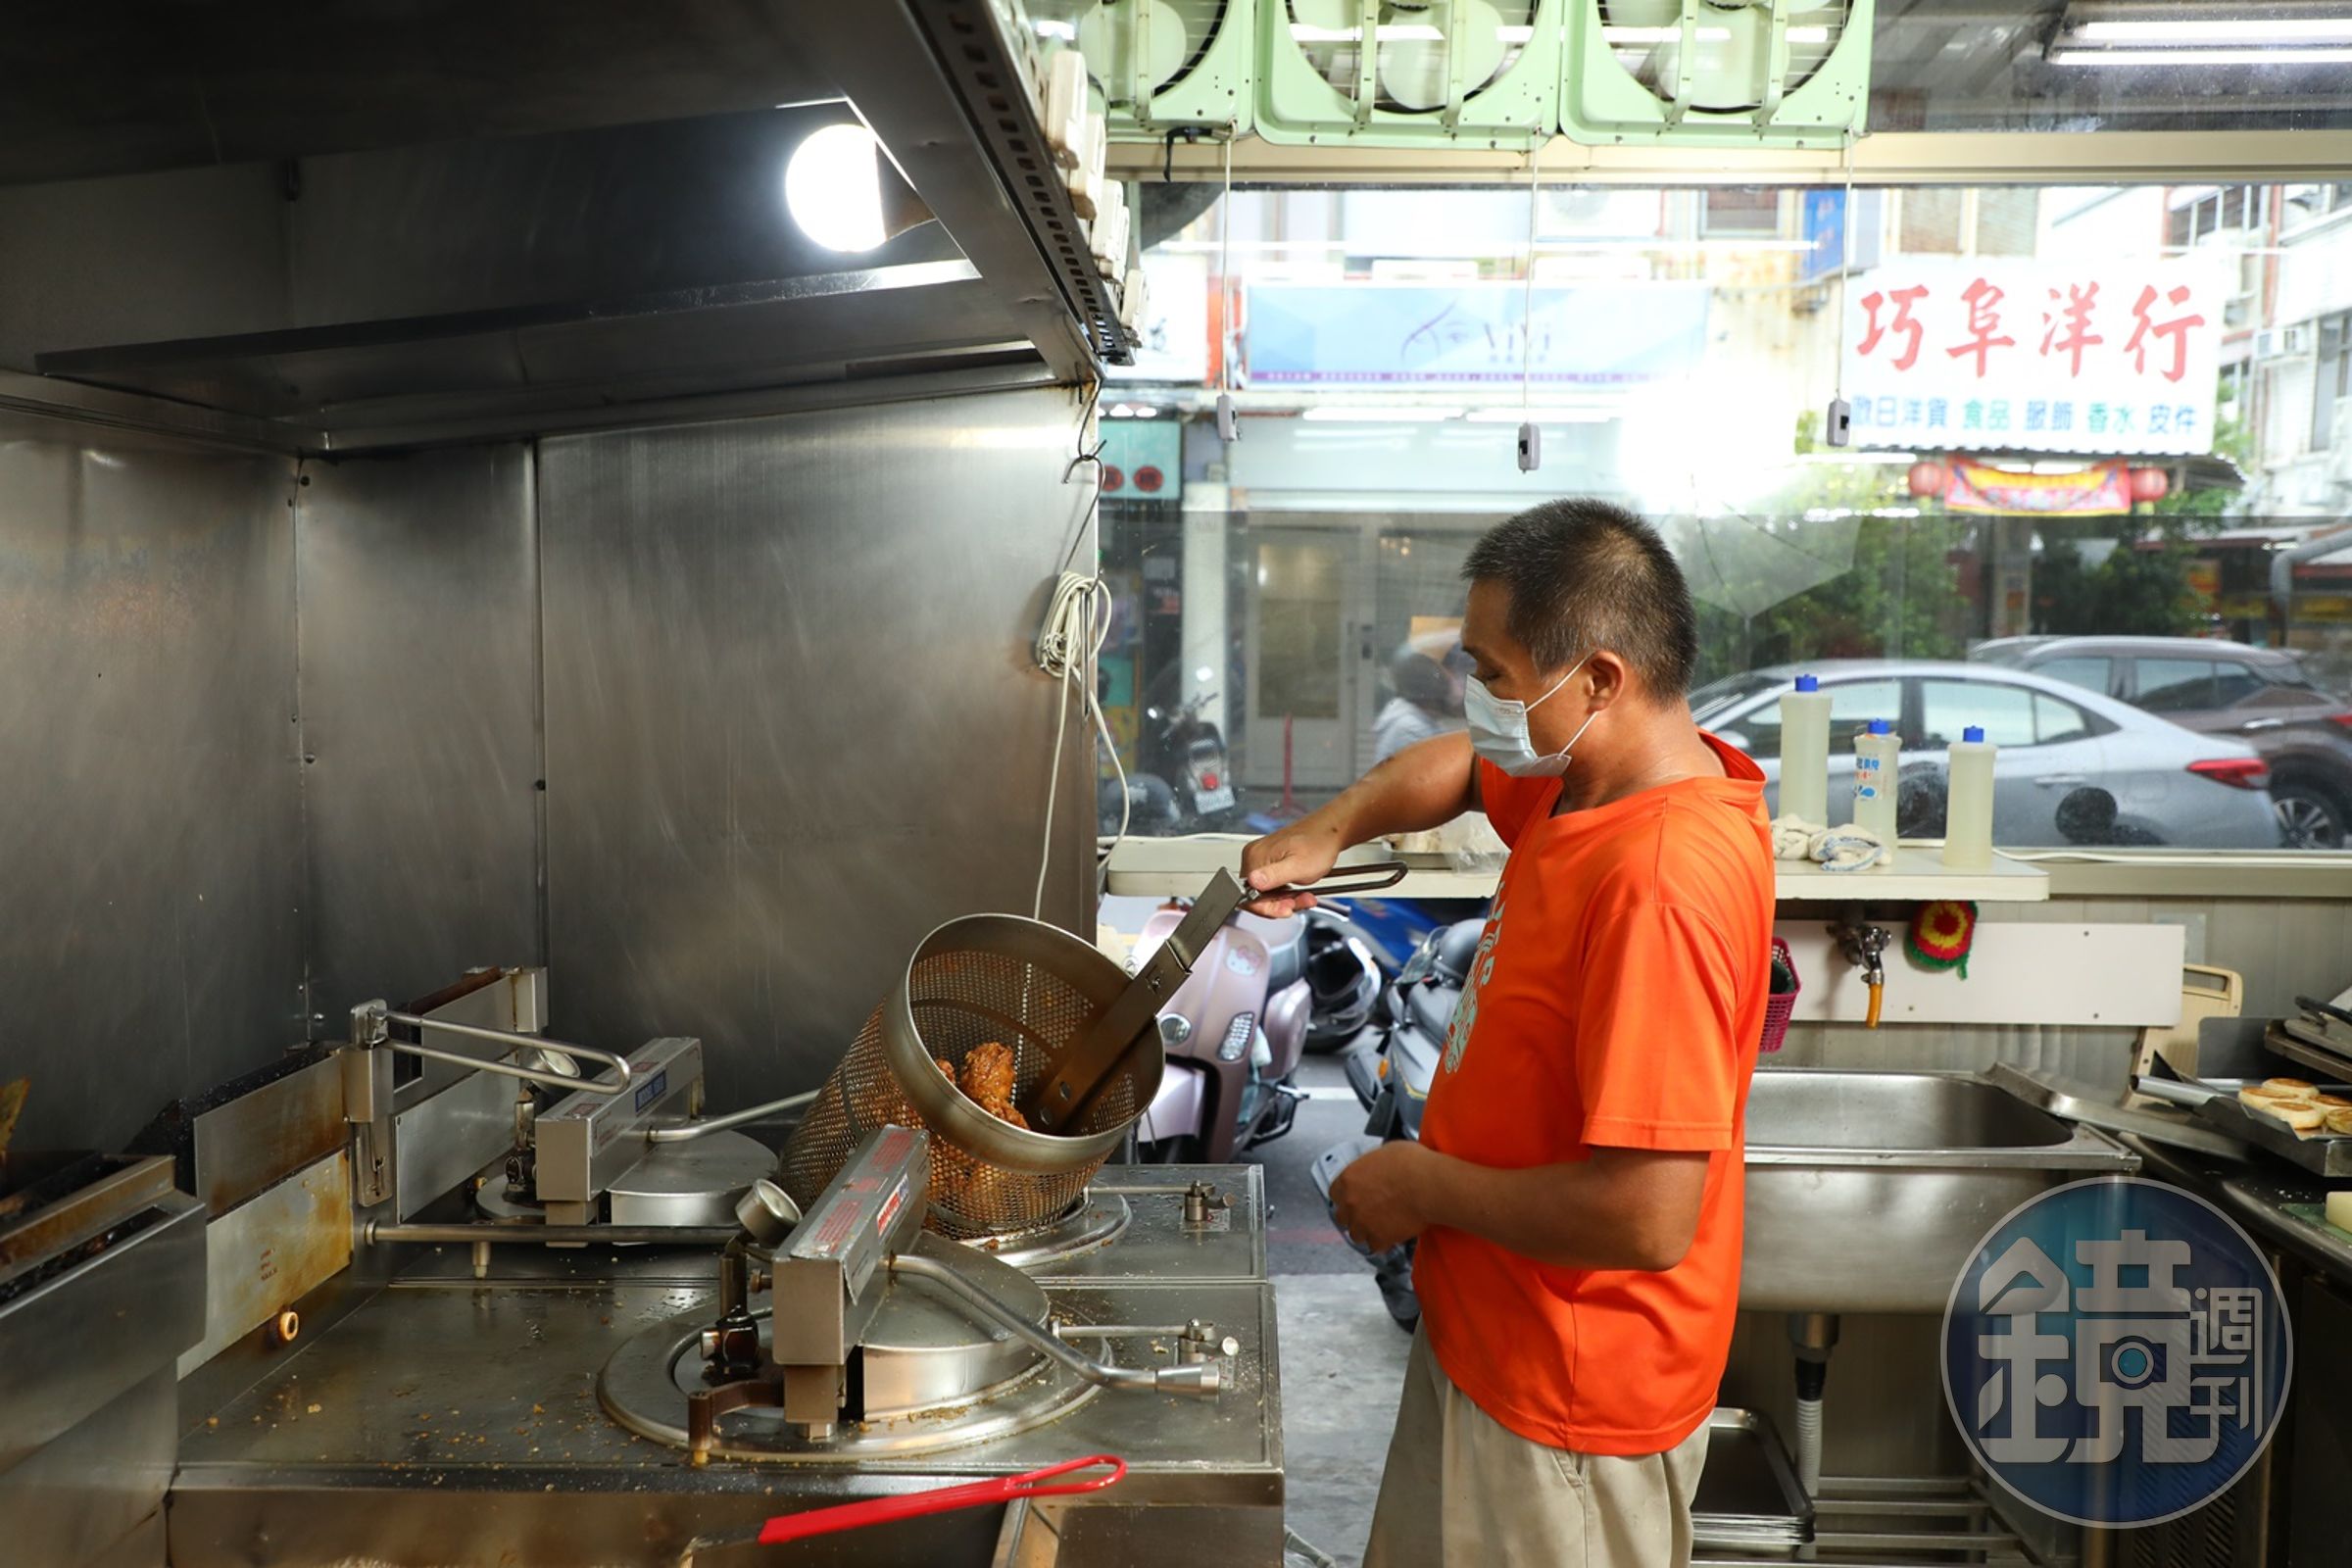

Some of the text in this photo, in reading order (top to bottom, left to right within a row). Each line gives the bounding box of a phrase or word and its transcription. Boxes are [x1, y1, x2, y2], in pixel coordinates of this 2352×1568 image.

[1856, 277, 2206, 383] 巧阜洋行
[1962, 398, 2012, 431] 食品
[2025, 400, 2073, 431] 服飾
[2088, 401, 2137, 434] 香水
[2147, 403, 2197, 436] 皮件
